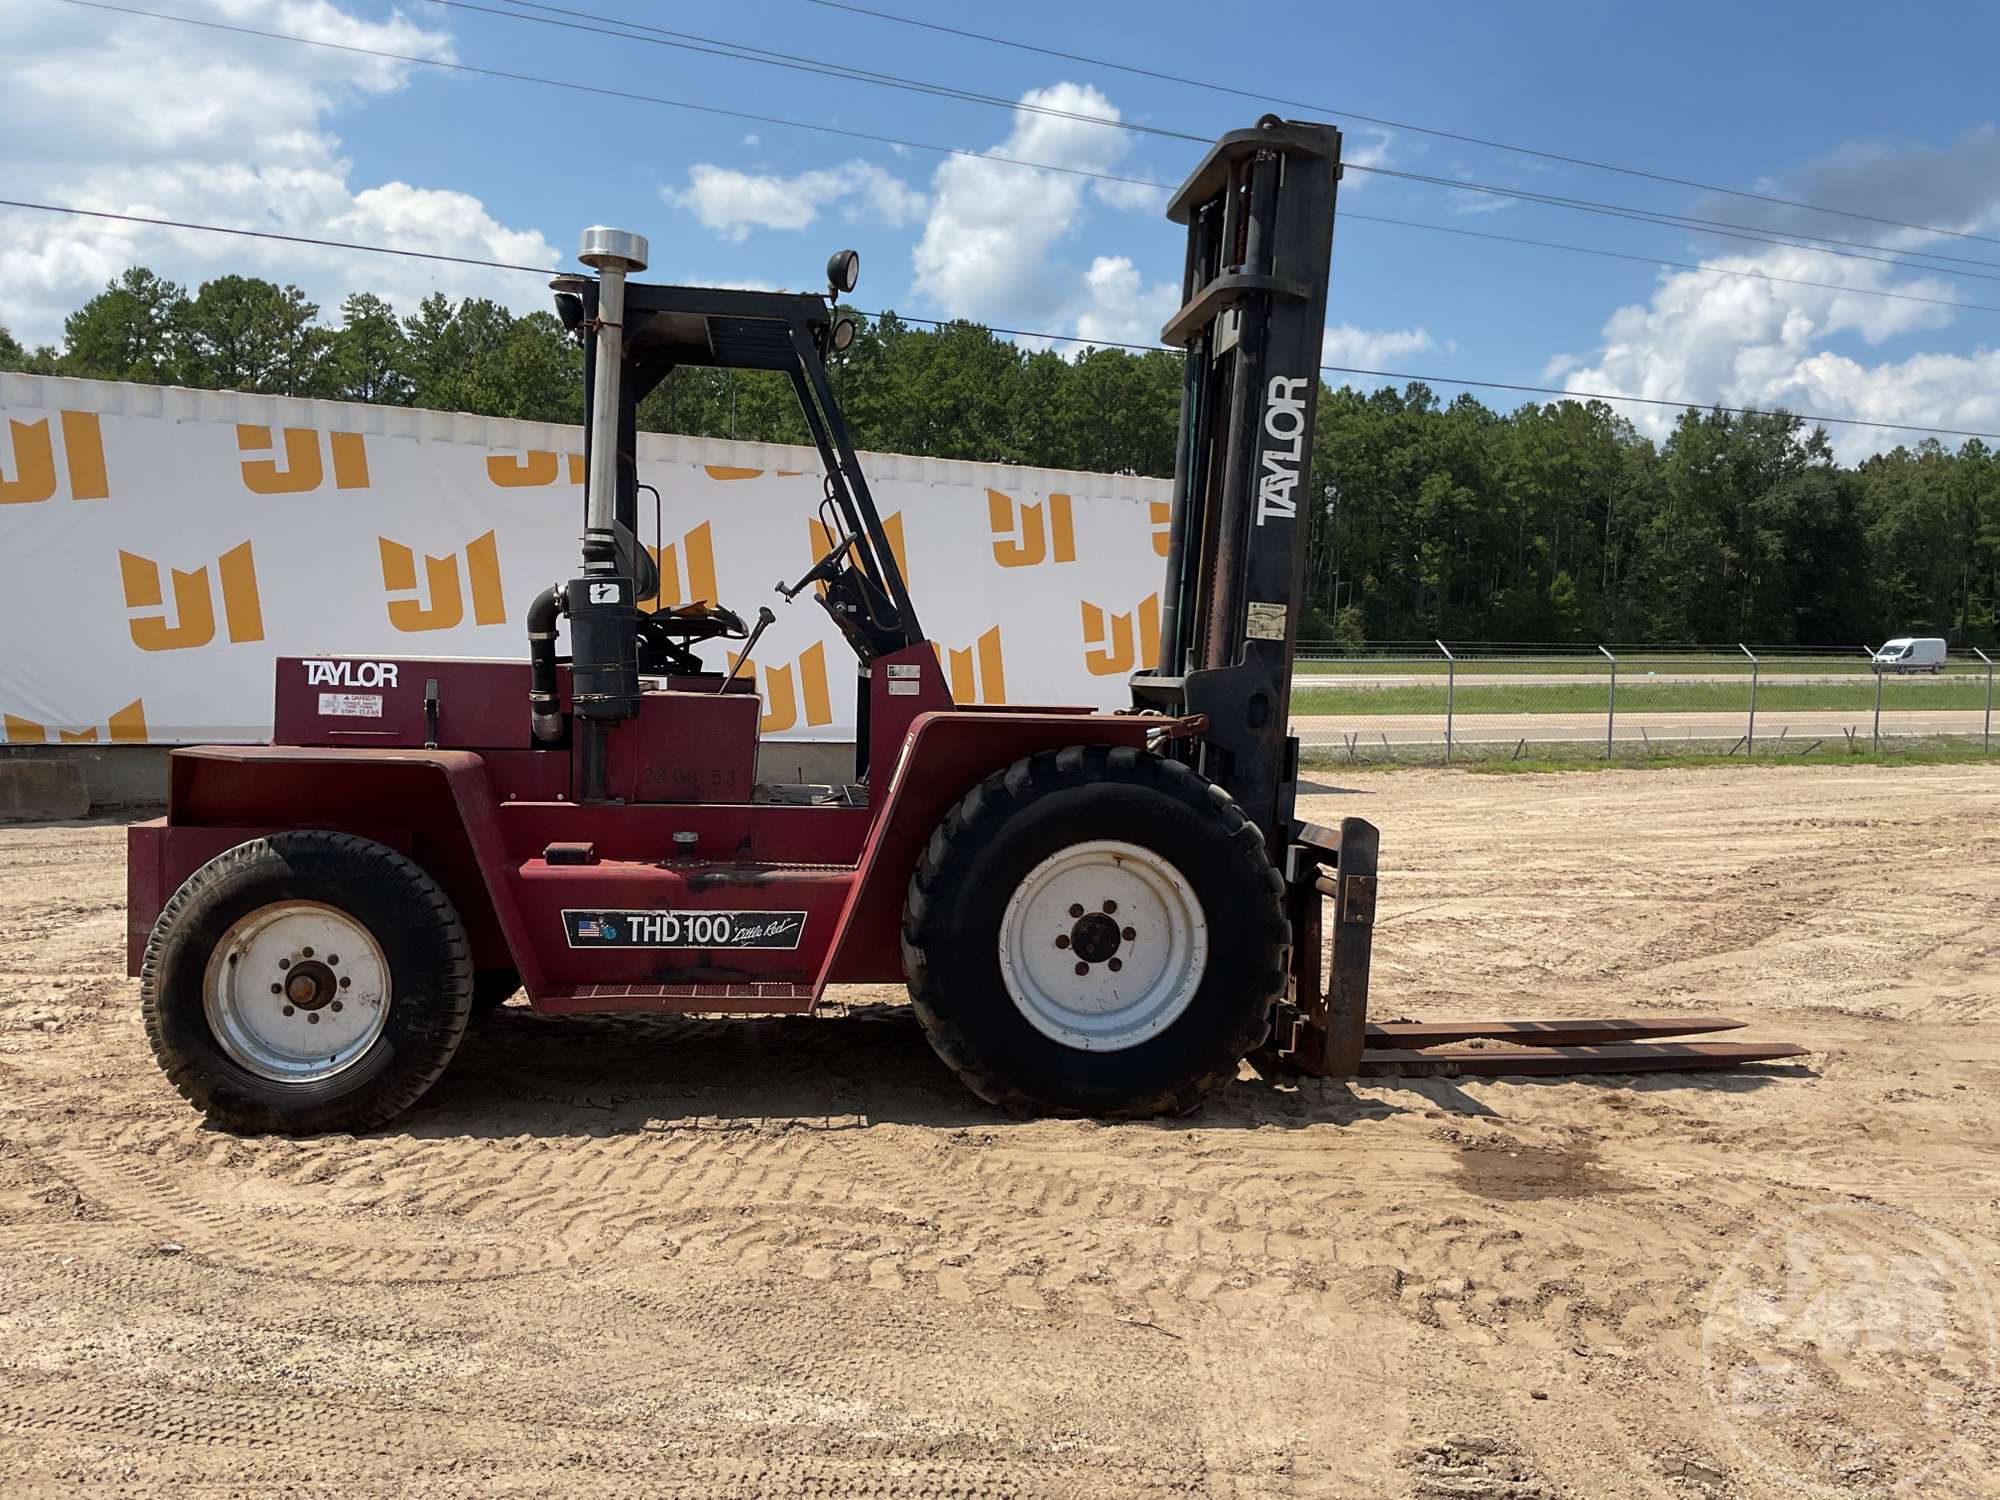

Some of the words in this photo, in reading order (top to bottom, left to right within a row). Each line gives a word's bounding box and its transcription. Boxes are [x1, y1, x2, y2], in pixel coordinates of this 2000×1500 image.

[1256, 375, 1308, 526] TAYLOR
[302, 660, 398, 688] TAYLOR
[627, 916, 680, 942] THD
[684, 916, 731, 943] 100
